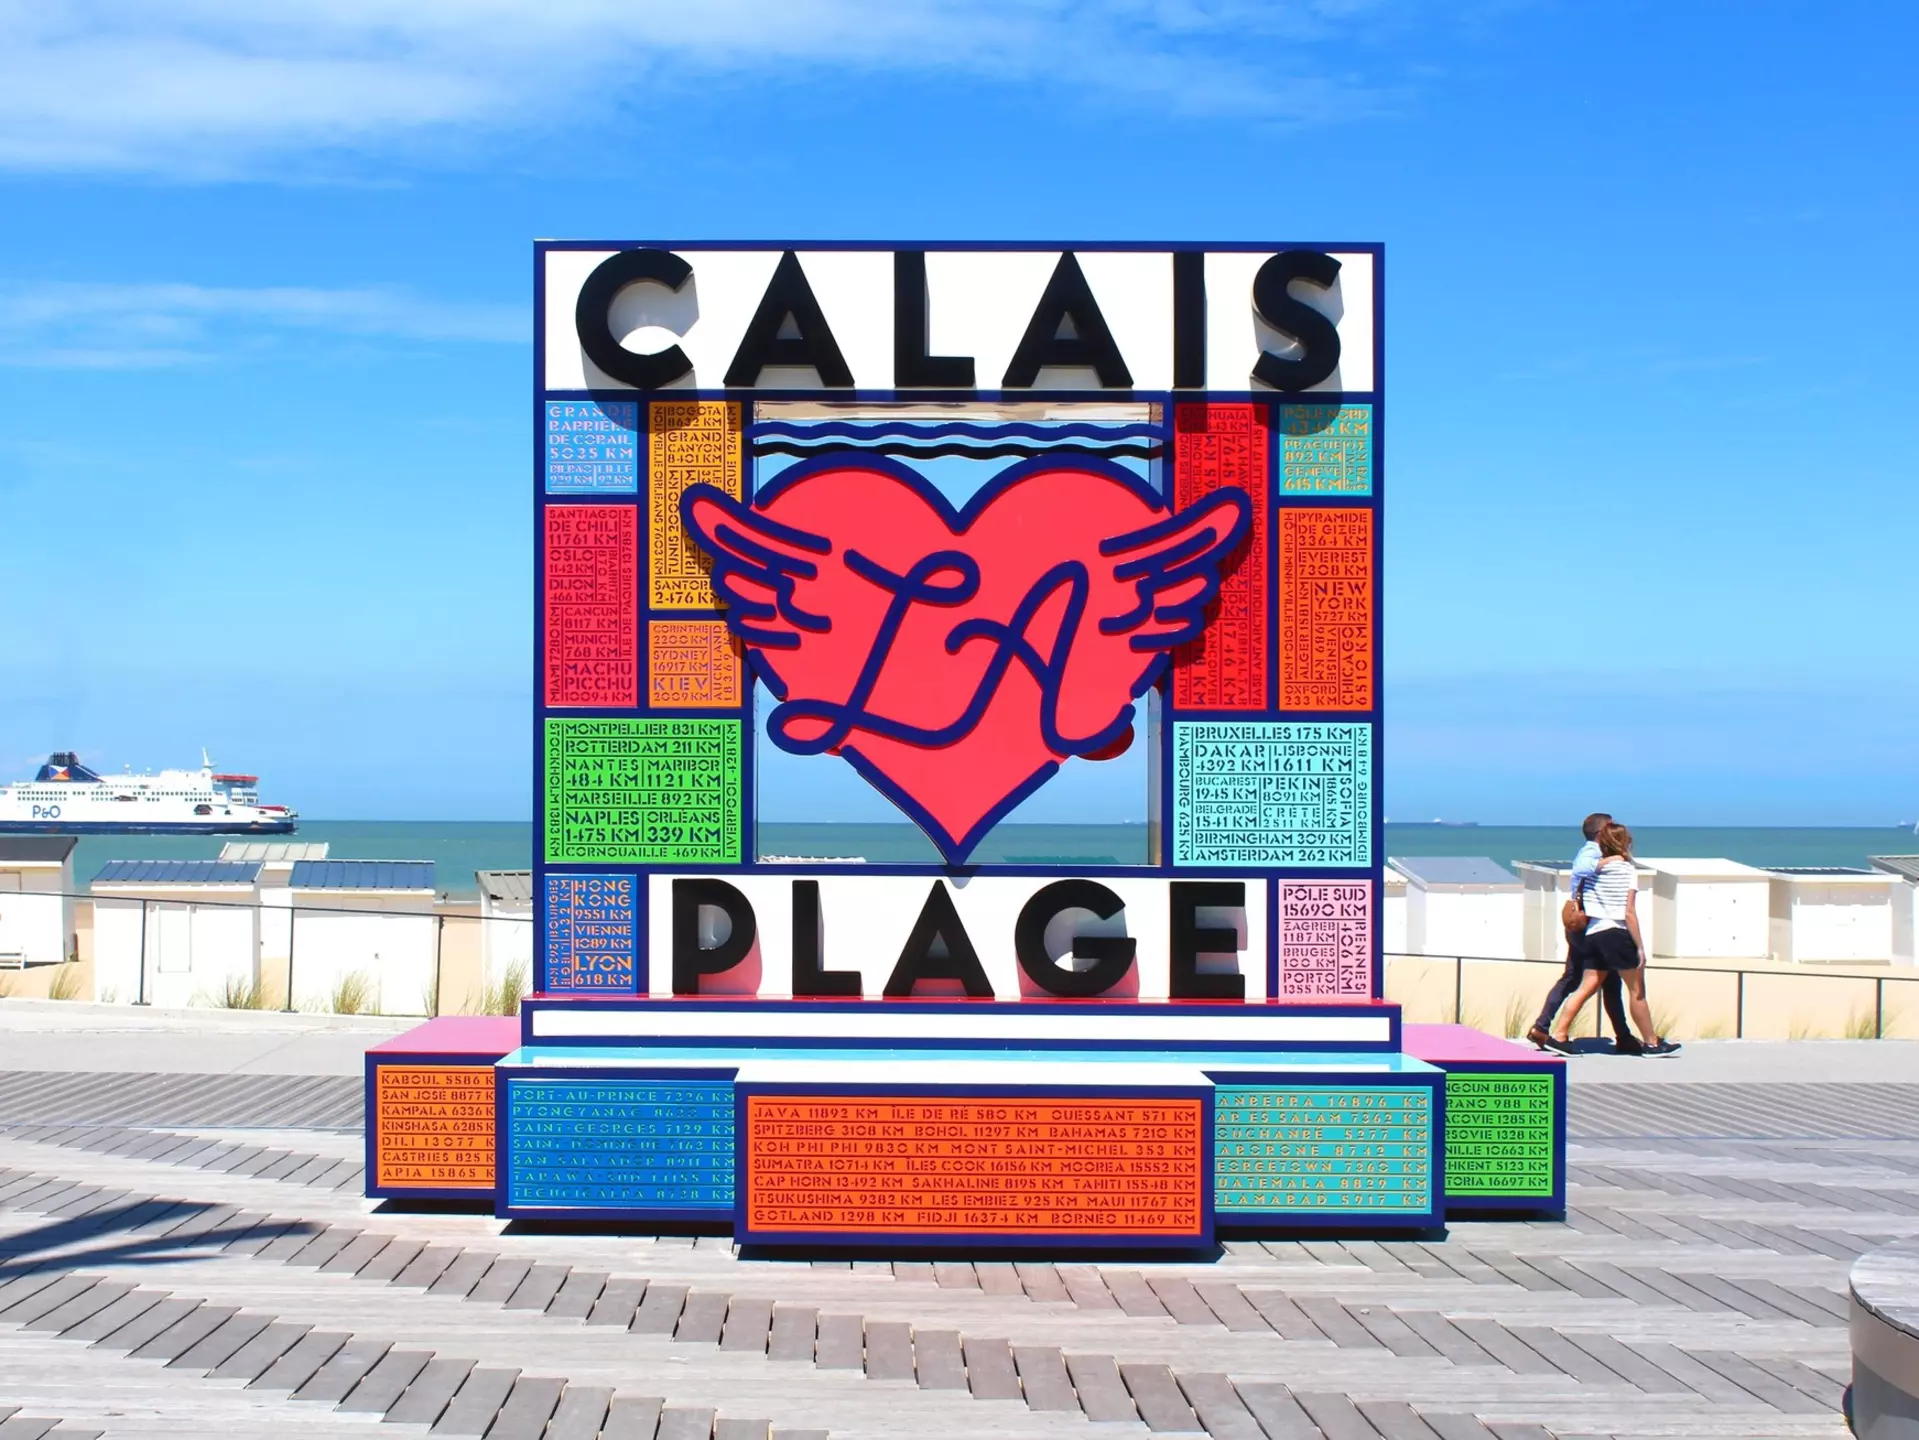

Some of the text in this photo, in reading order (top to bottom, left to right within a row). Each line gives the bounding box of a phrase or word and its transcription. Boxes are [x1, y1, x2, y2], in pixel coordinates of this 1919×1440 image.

[576, 248, 1342, 392] CALAIS
[549, 434, 632, 444] DE CORAIL
[668, 432, 721, 442] GRAND
[550, 448, 632, 459] 5035 KM
[668, 444, 721, 453] CANYON
[668, 454, 721, 463] 8401 KM
[549, 509, 618, 519] SANTIAGO
[1299, 513, 1367, 523] PYRAMIDE
[549, 521, 618, 532] DE CHILI
[1299, 525, 1367, 534] DE GIZEH
[549, 534, 618, 545] 11761 KM
[1299, 536, 1367, 546] 3364 KM
[550, 551, 594, 562] OSLO
[1299, 552, 1367, 563] EVEREST
[1300, 565, 1367, 575] 7308 KM
[550, 579, 594, 590] DIJON
[1315, 582, 1366, 595] NEW
[1315, 598, 1366, 609] YORK
[565, 607, 618, 616] CANCUN
[1315, 612, 1367, 621] 5727 KM
[565, 619, 618, 629] 8117 KM
[653, 625, 708, 633] CORINTHE
[565, 634, 618, 645] MUNICH
[653, 635, 708, 644] 2200 KM
[550, 606, 560, 701] MIAMI 7280 KM
[565, 647, 618, 657] 768 KM
[653, 650, 708, 660] SYDNEY
[767, 548, 1136, 755] LA
[565, 663, 632, 675] MACHU
[654, 662, 708, 671] 16917 KM
[565, 677, 632, 690] PICCHU
[653, 677, 708, 691] KIEV
[1285, 685, 1337, 694] OXFORD
[565, 691, 632, 701] 10094 KM
[654, 692, 708, 701] 2009 KM
[1285, 696, 1337, 705] 233 KM
[566, 723, 721, 735] MONTPELLIER 831 KM
[1195, 727, 1352, 740] BRUXELLES 175 KM
[566, 741, 720, 753] ROTTERDAM 211 KM
[1195, 745, 1265, 757] DAKAR
[1274, 746, 1352, 756] LISBONNE
[566, 759, 639, 771] NANTES
[648, 760, 720, 771] MARIBOR
[1196, 760, 1265, 771] 4392 KM
[1275, 759, 1352, 771] 1611 KM
[566, 773, 638, 786] 484 KM
[648, 774, 720, 787] 1121 KM
[1263, 777, 1320, 789] PEKIN
[550, 723, 559, 856] STOCKHOLM 1383 KM
[566, 793, 720, 805] MARSEILLE 892 KM
[1263, 792, 1320, 801] 8091 KM
[32, 806, 61, 818] P&O
[566, 811, 639, 824] NAPLES
[566, 828, 639, 842] 1475 KM
[648, 827, 720, 842] 339 KM
[1195, 833, 1352, 844] BIRMINGHAM 309 KM
[566, 847, 720, 857] CORNOUAILLE 469 KM
[1195, 850, 1352, 861] AMSTERDAM 262 KM
[574, 880, 631, 892] HONG
[1334, 888, 1366, 900] SUD
[574, 895, 631, 906] KONG
[575, 909, 631, 920] 9551 KM
[1284, 904, 1366, 916] 15690 KM
[575, 925, 631, 935] VIENNE
[1284, 922, 1335, 931] ZAGREB
[672, 878, 1245, 999] PLAGE
[1284, 933, 1335, 942] 1187 KM
[575, 939, 632, 948] 1089 KM
[574, 956, 632, 971] LYON
[575, 974, 632, 985] 618 KM
[382, 1075, 480, 1085] KABOUL 5586
[1494, 1084, 1548, 1093] 8869 KM
[1494, 1100, 1548, 1108] 988 KM
[382, 1106, 483, 1116] KAMPALA 6336
[755, 1107, 878, 1118] JAVA 11892 KM
[1052, 1110, 1196, 1121] OUESSANT 571 KM
[1279, 1113, 1341, 1123] SALAM
[1404, 1113, 1427, 1123] KM
[382, 1122, 483, 1131] KINSHASA 6285
[755, 1125, 904, 1136] SPITZBERG 3108 KM
[1050, 1127, 1196, 1138] BAHAMAS 7210 KM
[1060, 1162, 1195, 1173] MOOREA 15552 KM
[755, 1210, 904, 1222] GOTLAND 1298 KM
